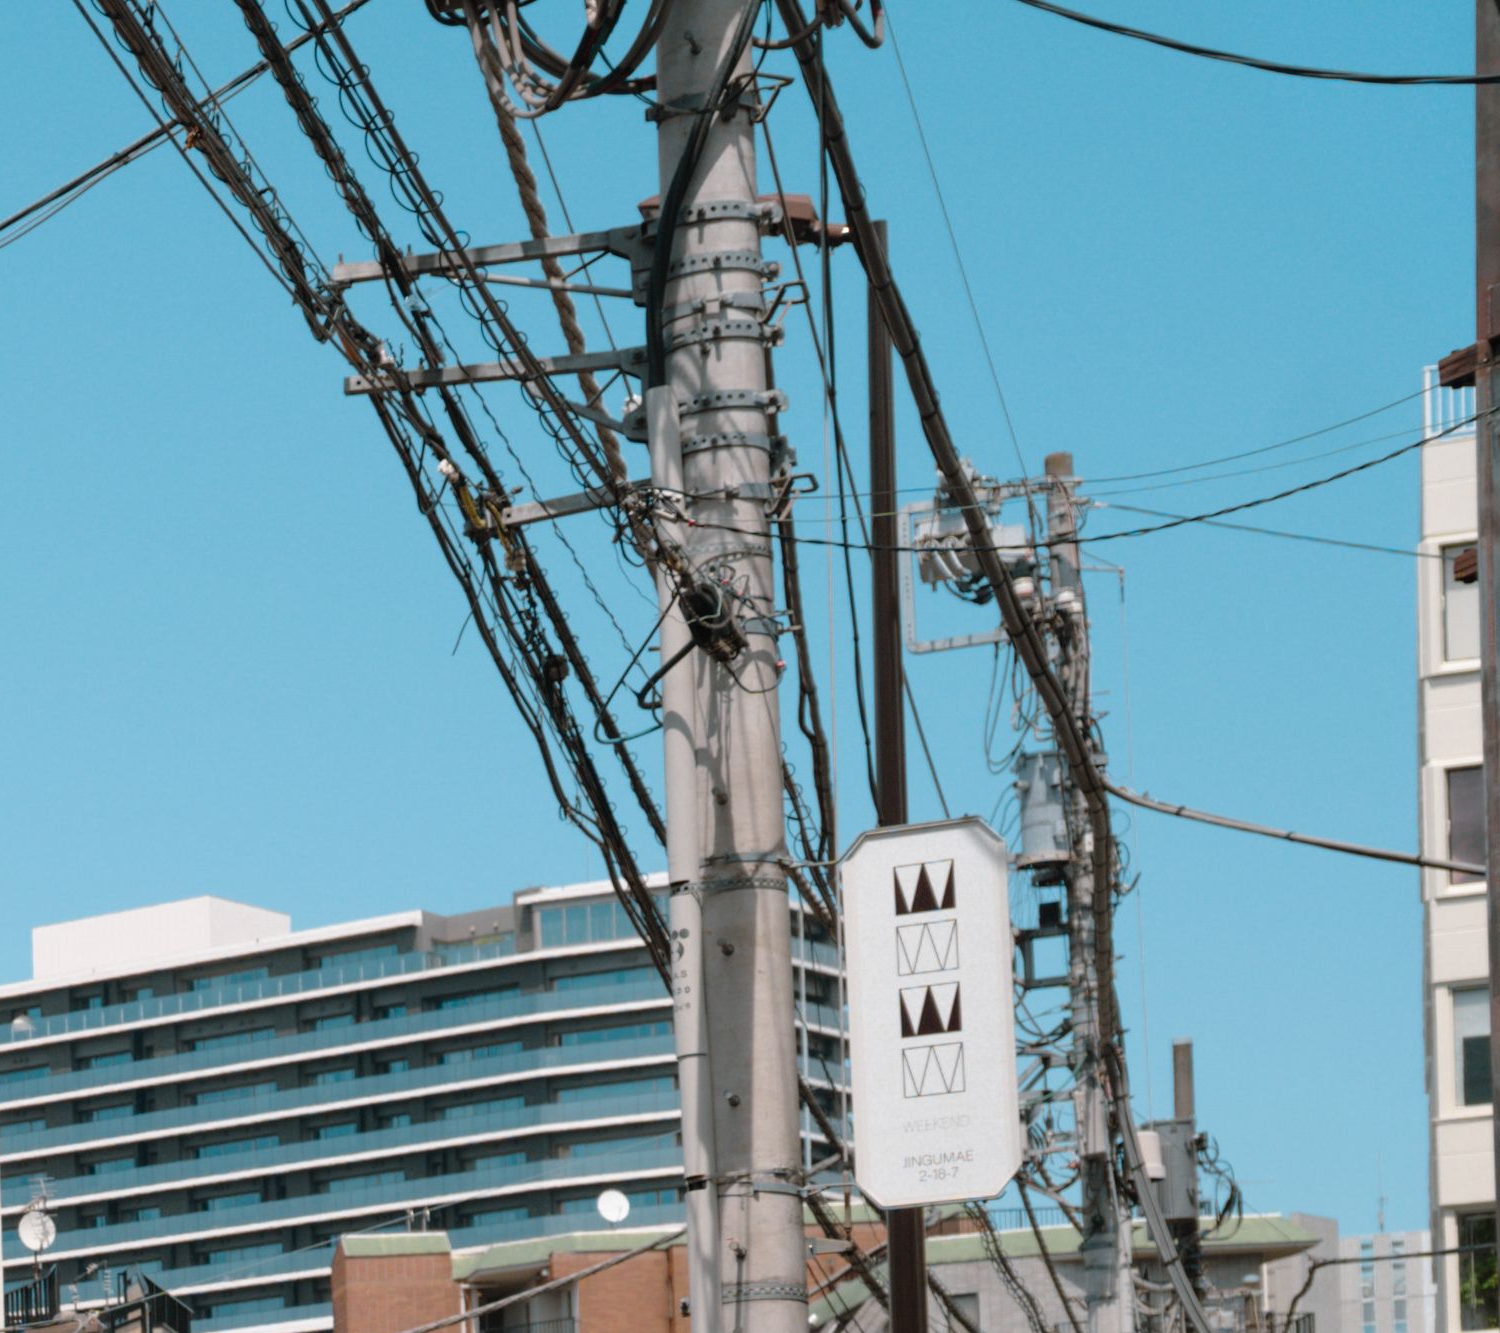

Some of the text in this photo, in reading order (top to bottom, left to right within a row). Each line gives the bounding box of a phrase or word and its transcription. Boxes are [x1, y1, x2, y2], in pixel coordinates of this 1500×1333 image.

[901, 1114, 971, 1134] WEEKEND
[902, 1149, 974, 1170] JINGUMAE
[918, 1166, 960, 1183] 2-18-7
